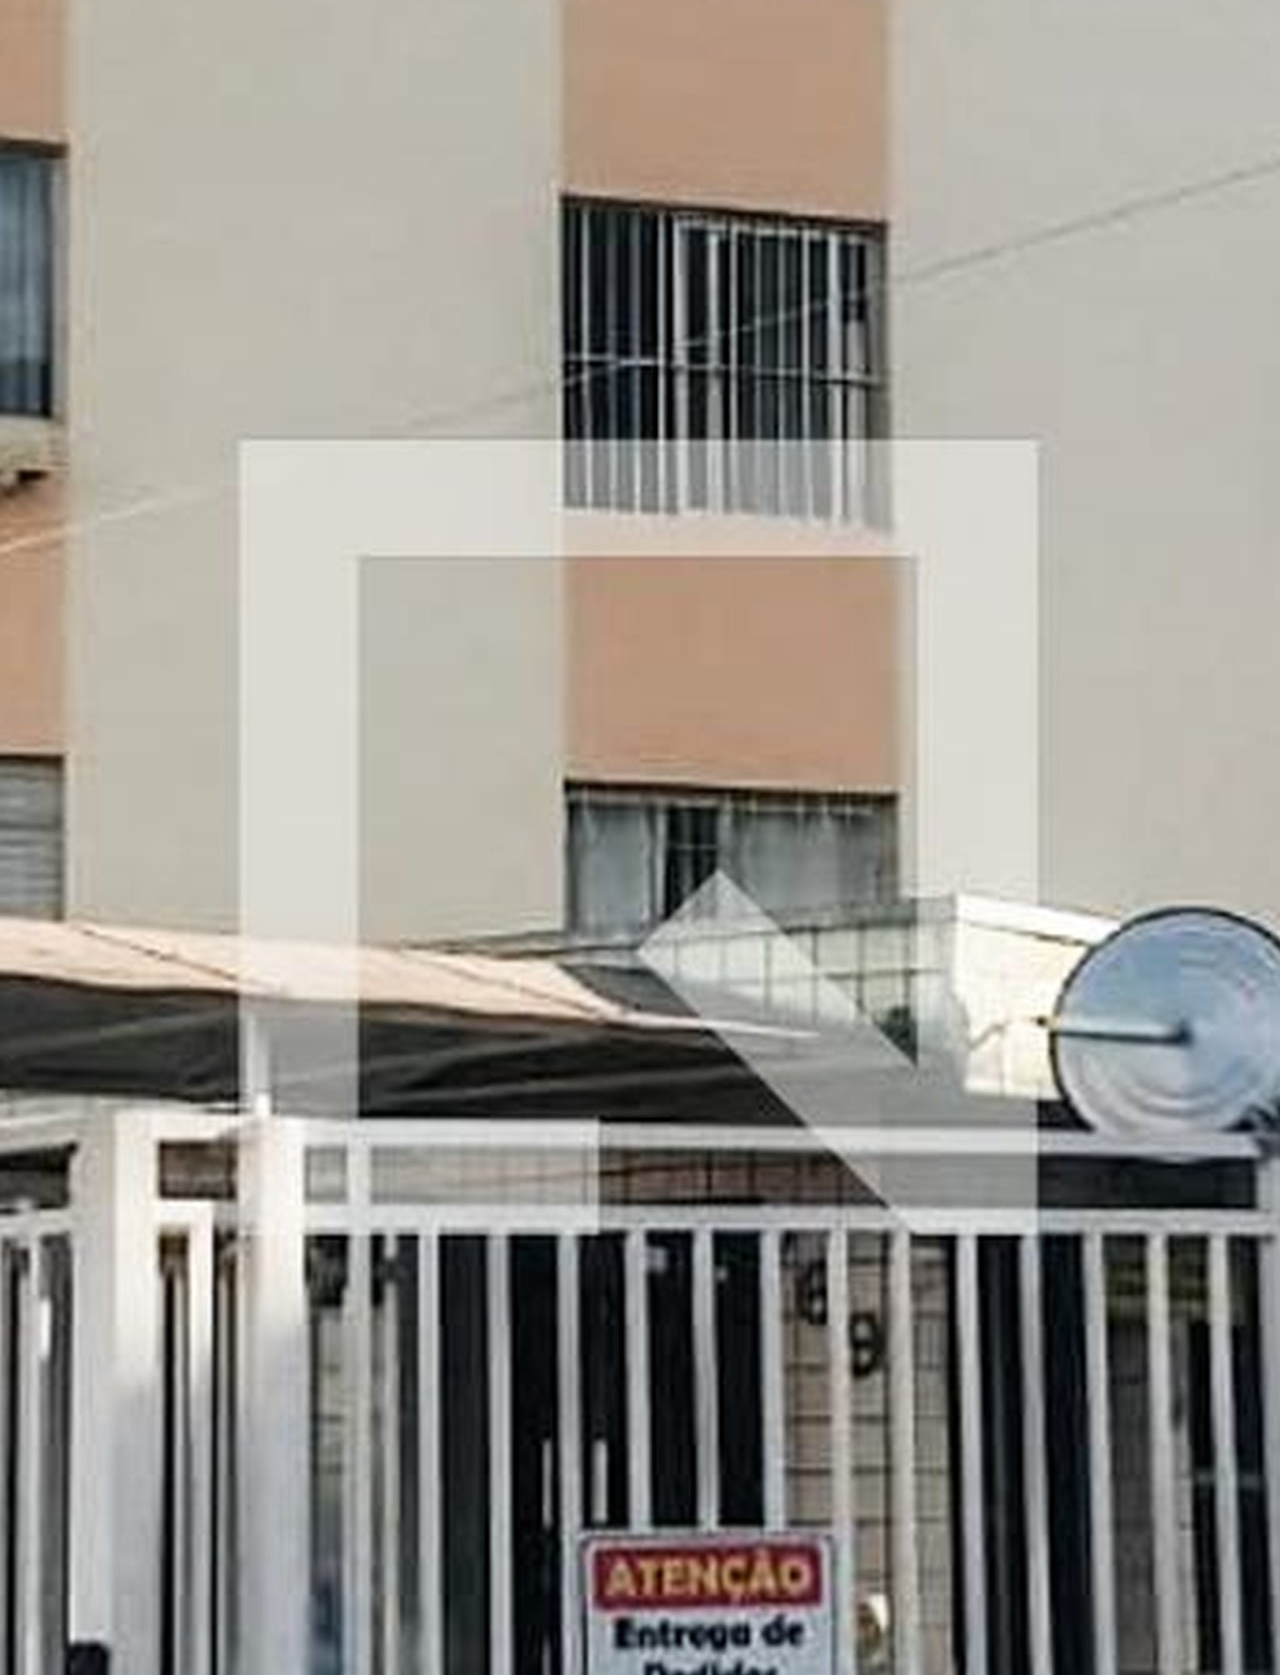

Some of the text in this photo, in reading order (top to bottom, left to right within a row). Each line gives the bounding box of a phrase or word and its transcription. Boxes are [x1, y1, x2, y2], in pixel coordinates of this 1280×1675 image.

[603, 1547, 814, 1605] ATENÇÃO
[613, 1616, 806, 1652] Entrega de
